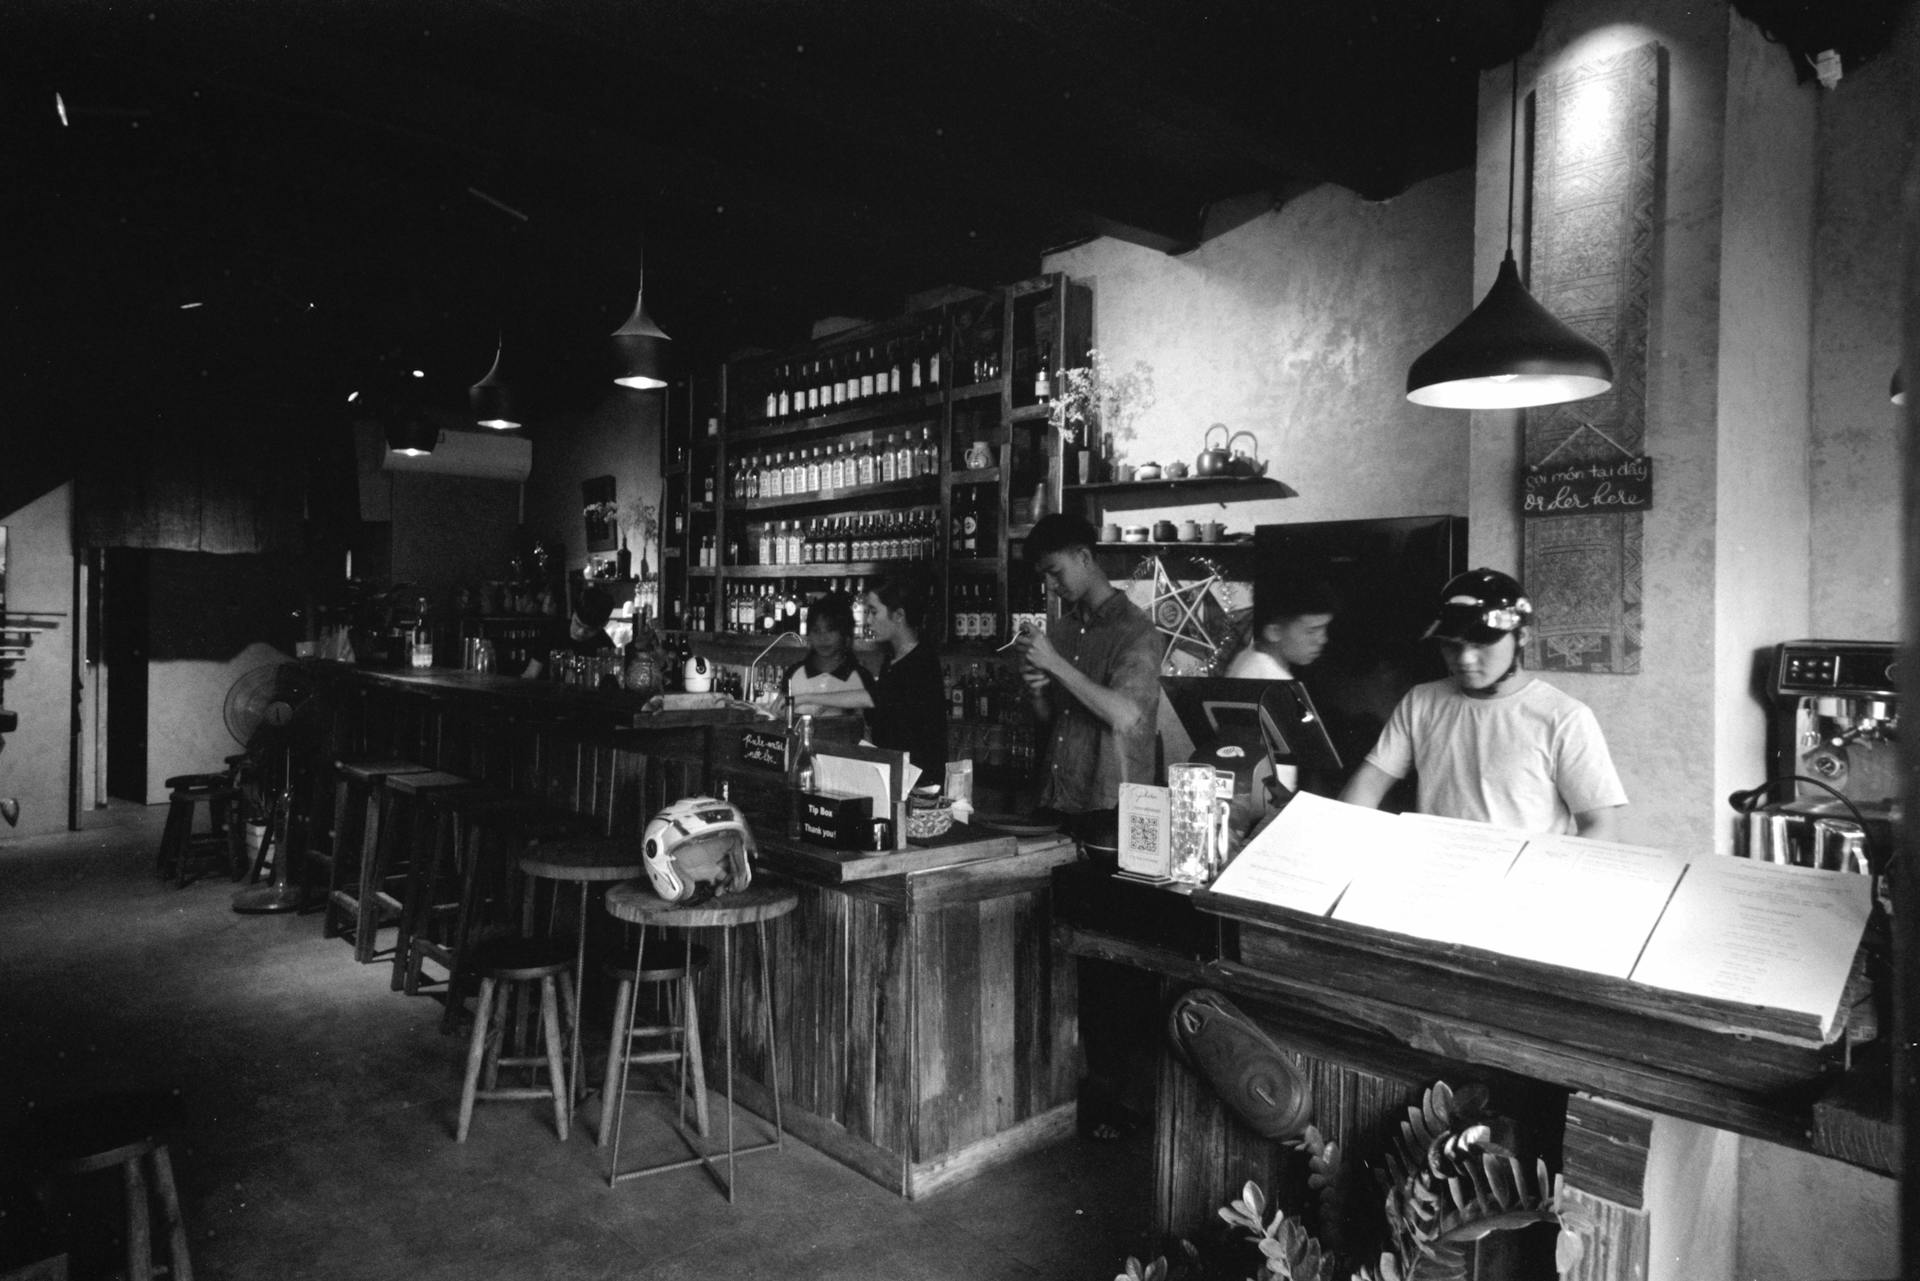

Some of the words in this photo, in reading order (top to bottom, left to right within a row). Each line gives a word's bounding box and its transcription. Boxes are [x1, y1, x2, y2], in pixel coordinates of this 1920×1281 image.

[1552, 466, 1584, 482] món
[1524, 485, 1590, 511] order
[1592, 481, 1645, 505] here
[808, 804, 819, 816] Tip
[820, 806, 833, 818] Box
[804, 822, 822, 836] Thank
[822, 829, 837, 839] you!
